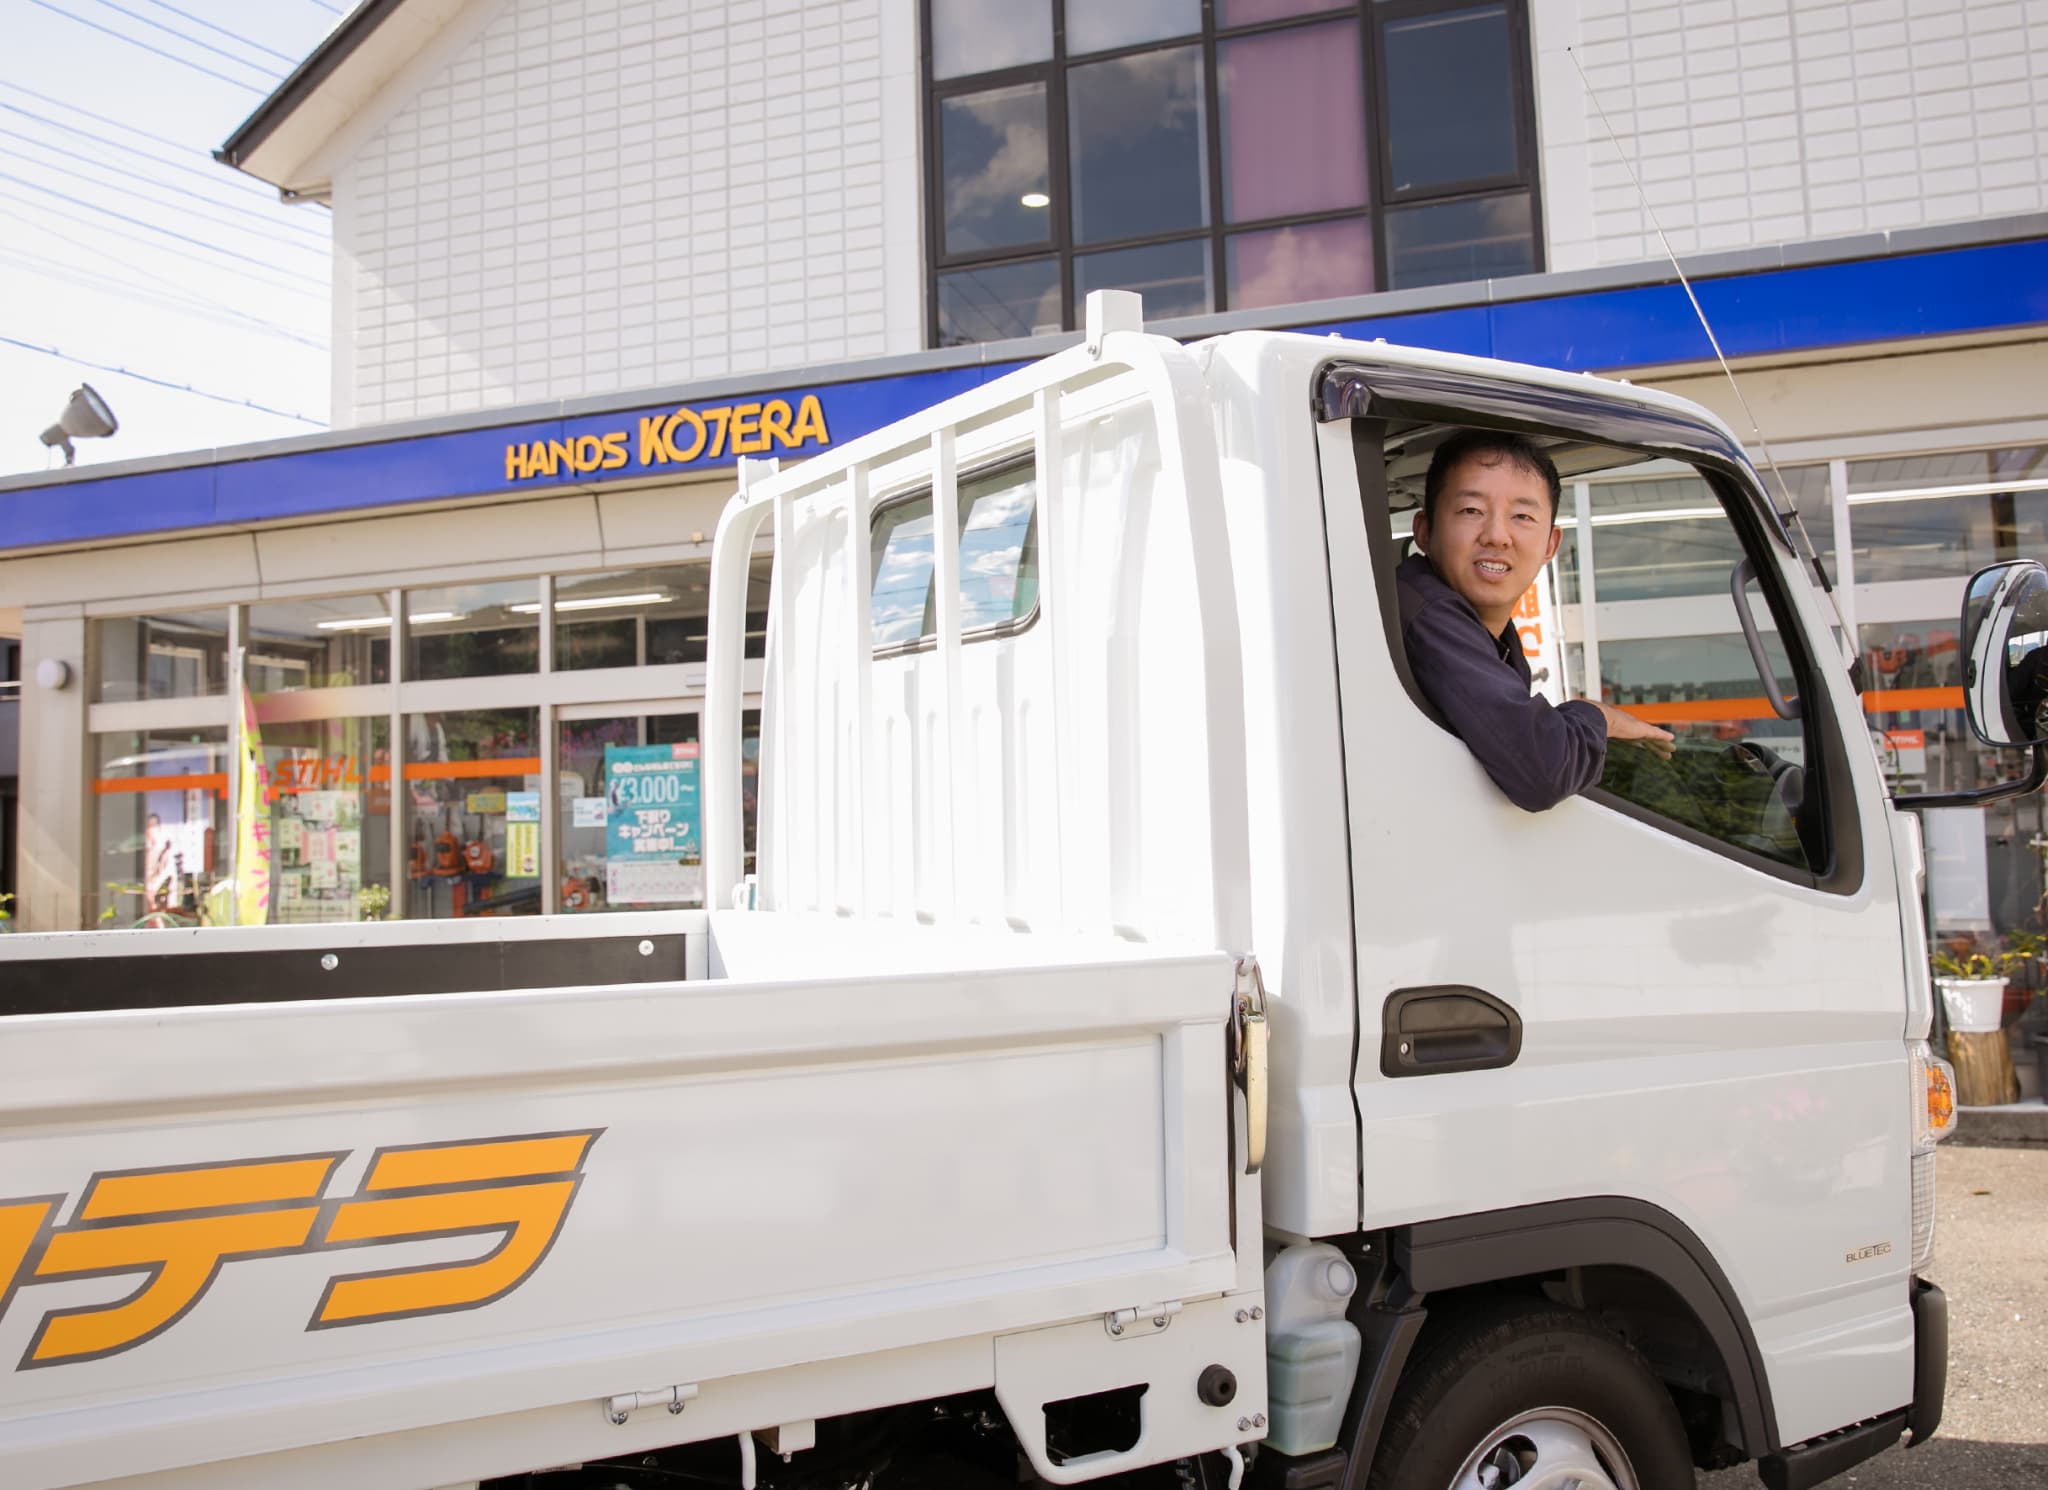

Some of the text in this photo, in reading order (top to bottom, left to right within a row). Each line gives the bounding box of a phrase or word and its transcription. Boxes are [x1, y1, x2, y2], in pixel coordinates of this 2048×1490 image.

[505, 395, 830, 481] HANDS KOTERA
[273, 756, 362, 786] STIHL
[618, 823, 689, 838] キャンペーン
[0, 1127, 608, 1372] テラ
